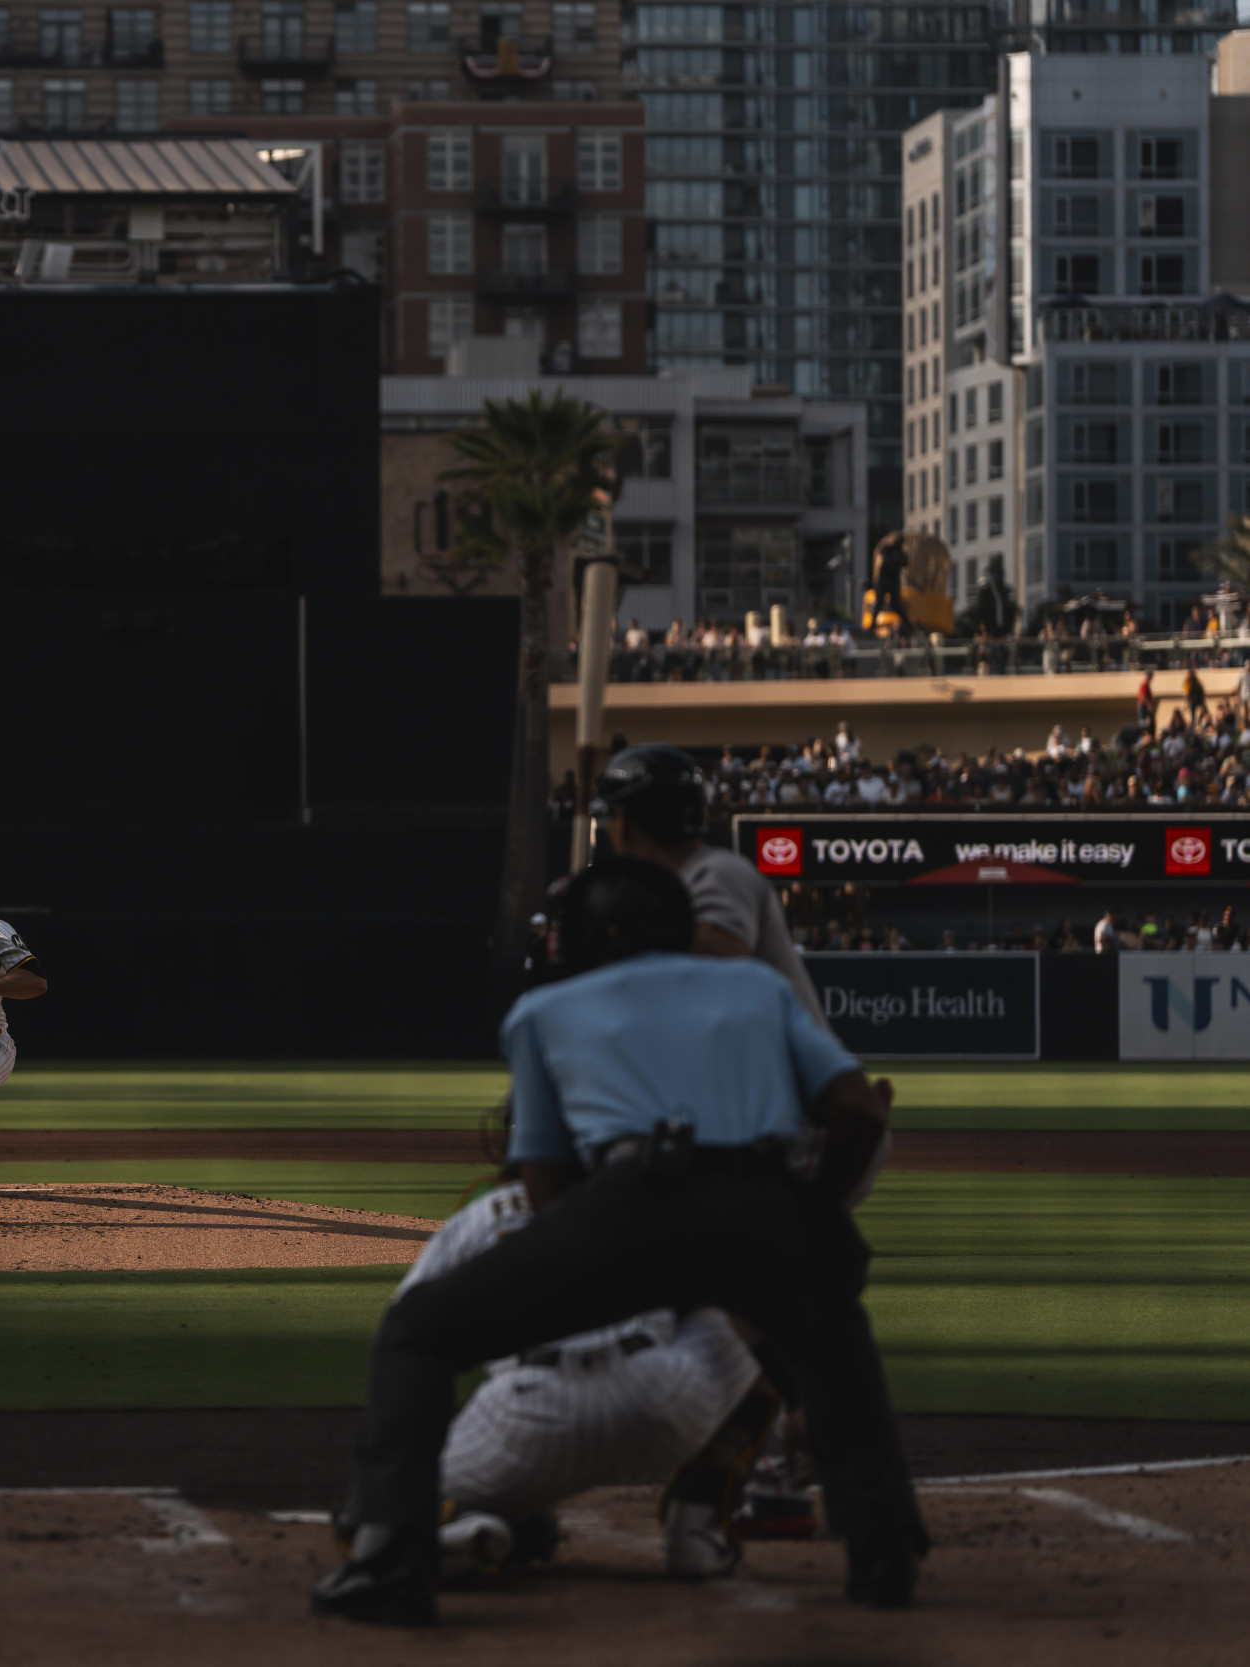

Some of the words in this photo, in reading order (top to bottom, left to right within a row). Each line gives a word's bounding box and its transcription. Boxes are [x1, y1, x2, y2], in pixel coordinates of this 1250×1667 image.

[811, 838, 925, 864] TOYOTA
[993, 839, 1058, 864] make
[1061, 839, 1077, 863] it
[1078, 842, 1136, 868] easy
[823, 986, 907, 1026] Diego
[911, 986, 1005, 1019] Health
